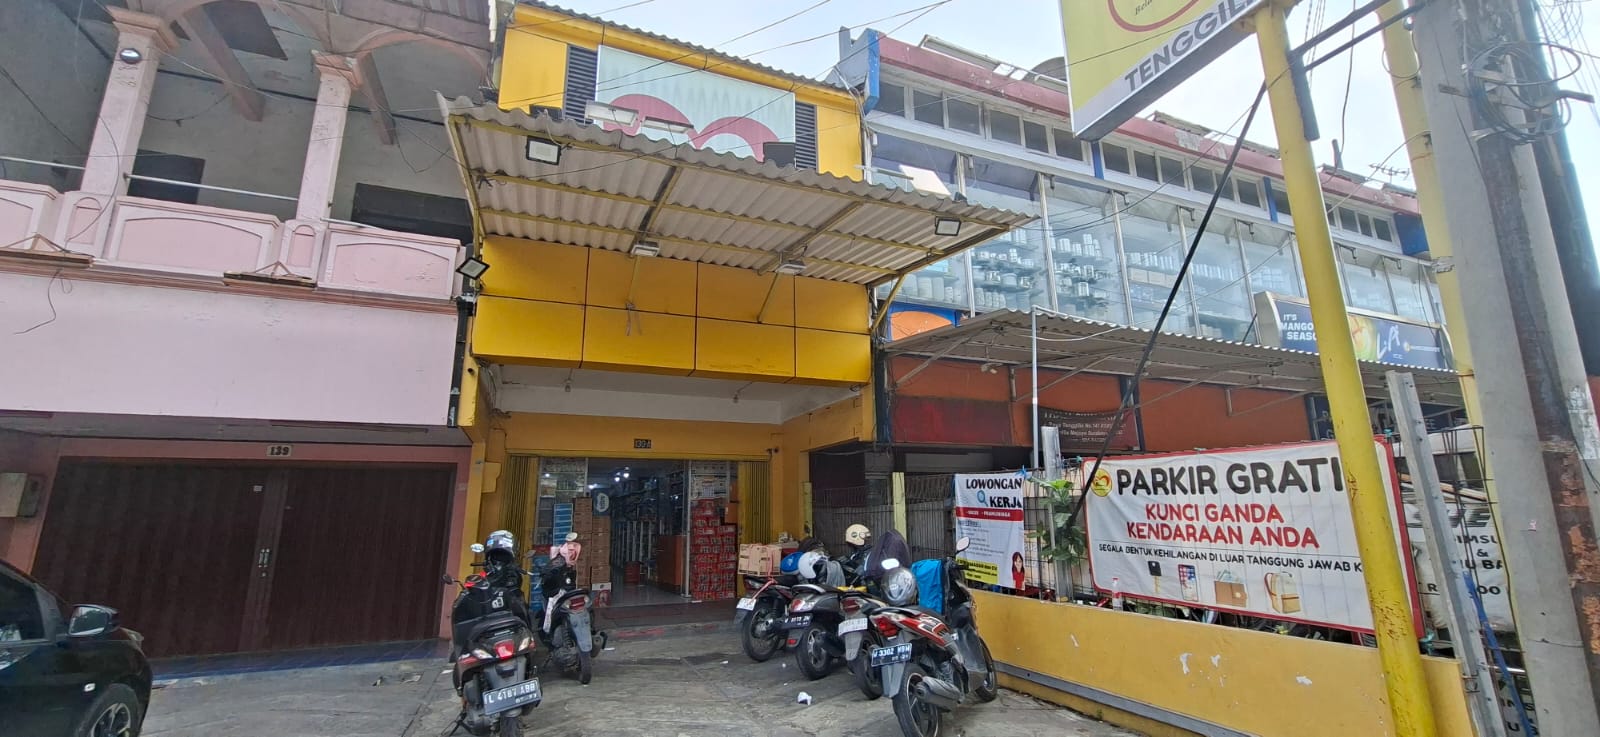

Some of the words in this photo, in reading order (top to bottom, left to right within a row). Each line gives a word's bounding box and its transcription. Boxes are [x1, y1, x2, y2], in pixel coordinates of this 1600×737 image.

[1124, 0, 1254, 92] TENGGIL
[1280, 322, 1314, 331] MANGO
[270, 446, 289, 456] 139
[966, 478, 1022, 490] LOWONGAN
[1116, 465, 1218, 495] PARKIR
[1226, 457, 1344, 494] GRATI
[1145, 503, 1200, 522] KUNCI
[1204, 503, 1285, 523] GANDA
[1127, 522, 1243, 545] KENDARAAN
[1250, 525, 1320, 548] ANDA
[1099, 543, 1123, 553] SEGALA
[1125, 546, 1153, 556] BENTUK
[1154, 548, 1210, 561] KEHILANGAN
[1209, 552, 1219, 562] DI
[1220, 552, 1245, 564] LUAR
[1246, 554, 1305, 569] TANGGUNG
[1307, 560, 1351, 572] JAWAB
[1476, 549, 1489, 557] &
[488, 694, 495, 703] L
